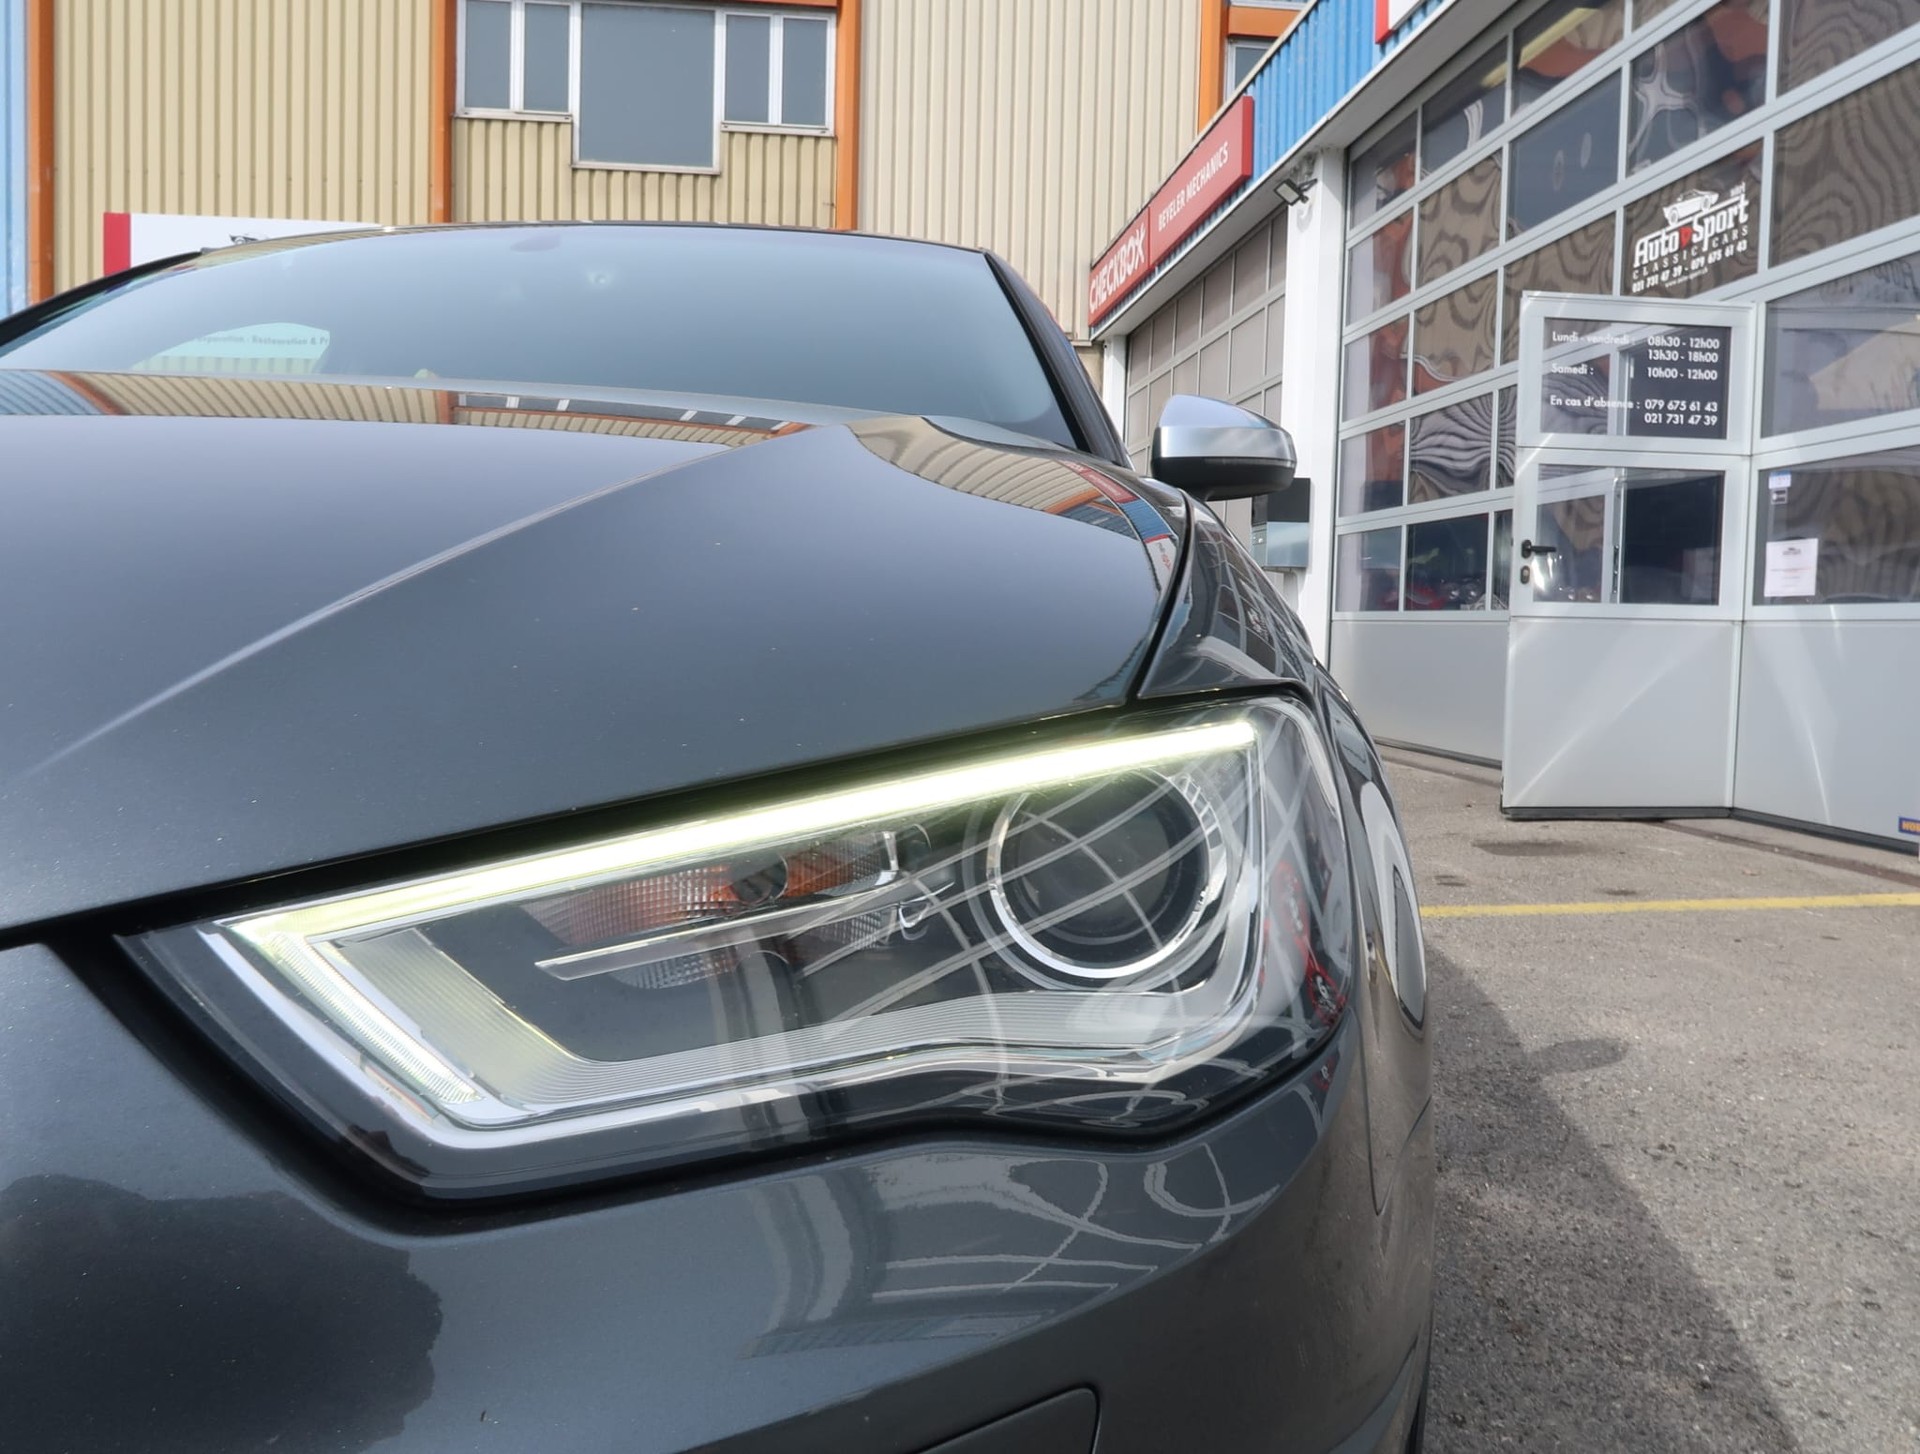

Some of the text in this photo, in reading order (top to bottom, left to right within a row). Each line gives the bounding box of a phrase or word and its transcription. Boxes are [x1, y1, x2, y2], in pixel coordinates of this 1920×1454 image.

[1159, 141, 1228, 232] BEYELER MECHANICS
[1633, 193, 1749, 268] Auto Sport
[1632, 225, 1748, 280] CLASSIC CARS
[1089, 223, 1146, 314] CHECKBOX
[1646, 274, 1659, 288] 731
[1661, 269, 1670, 281] 47
[1672, 265, 1682, 277] 39
[1690, 256, 1705, 271] 079
[1707, 249, 1722, 264] 675
[1724, 243, 1734, 258] 61
[1736, 239, 1747, 252] 43
[1552, 331, 1578, 342] Lundi
[1587, 334, 1629, 344] vendredi
[1648, 336, 1680, 347] 08h30
[1690, 337, 1720, 349] 12h00
[1648, 349, 1679, 361] 13h30
[1688, 351, 1718, 362] 18h00
[1551, 363, 1588, 374] Samedi
[1647, 366, 1678, 378] 10h00
[1687, 368, 1717, 380] 12h00
[1550, 395, 1562, 405] En
[1565, 398, 1581, 406] cas
[1644, 399, 1664, 410] 079
[1667, 400, 1686, 411] 675
[1689, 401, 1700, 411] 61
[1704, 401, 1718, 412] 43
[1644, 412, 1718, 426] 021 731 47 39
